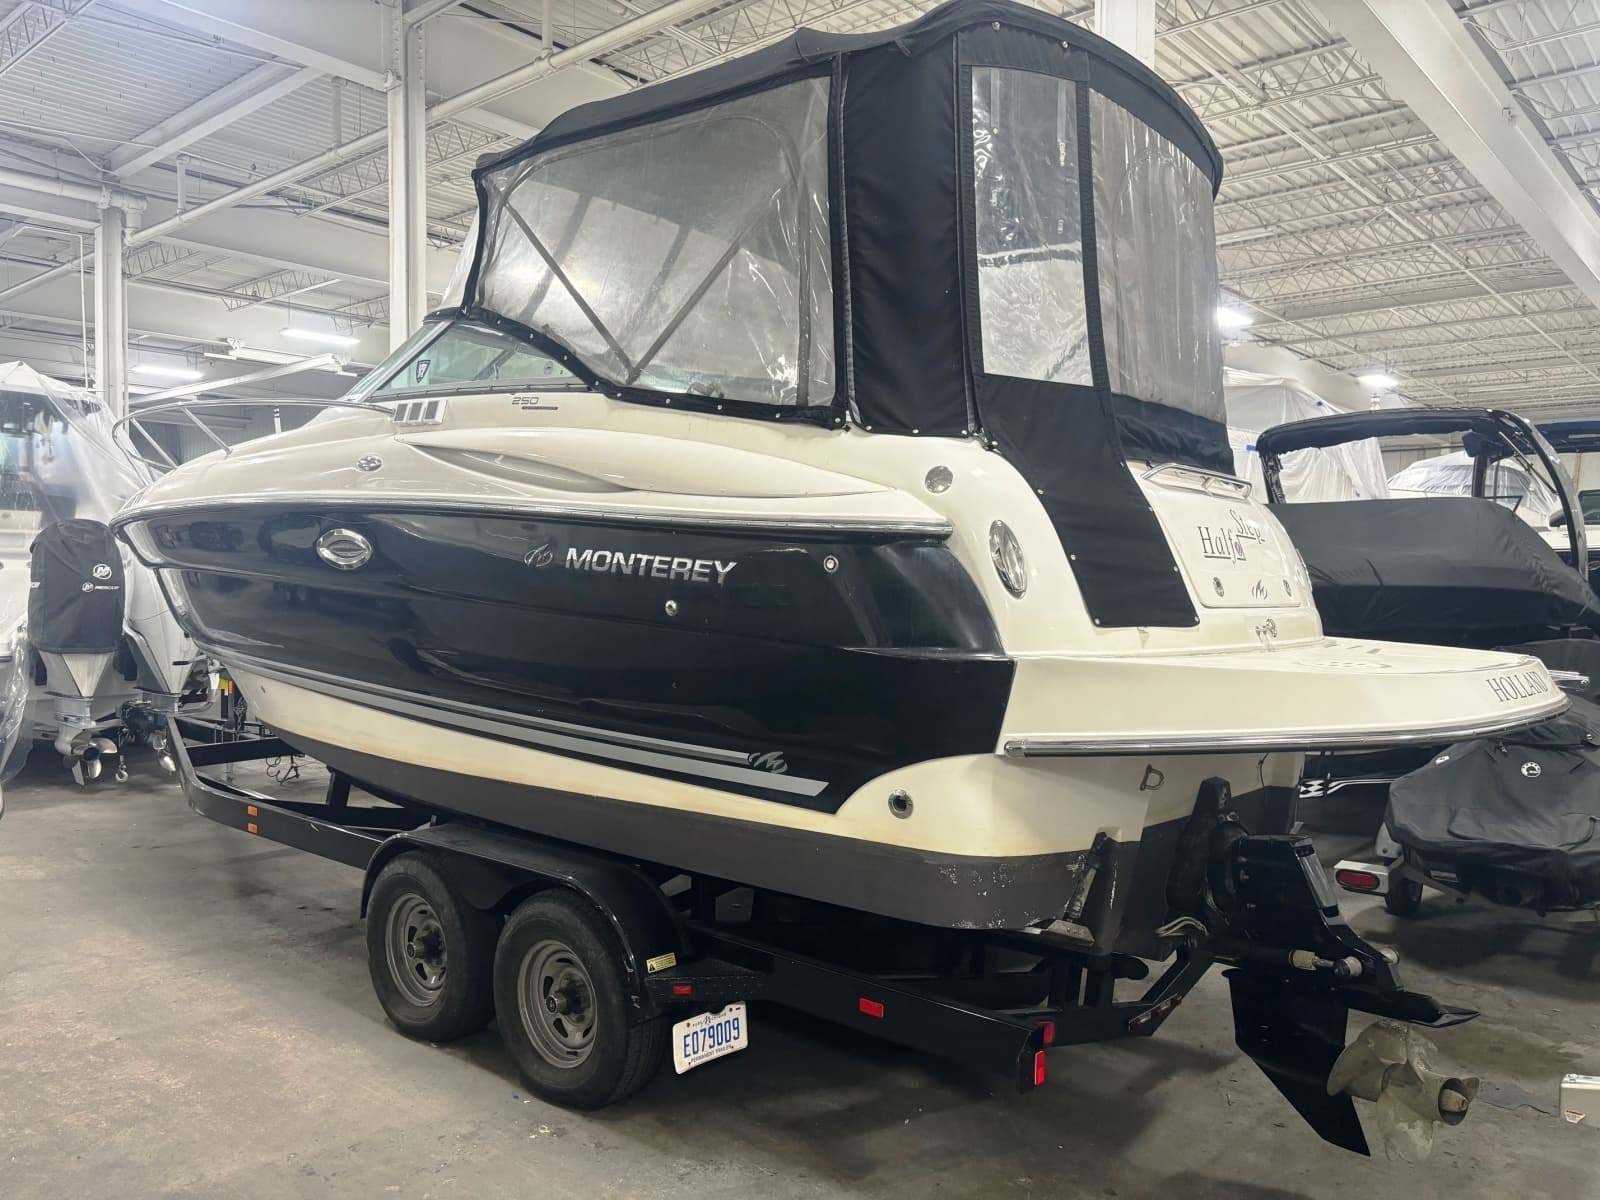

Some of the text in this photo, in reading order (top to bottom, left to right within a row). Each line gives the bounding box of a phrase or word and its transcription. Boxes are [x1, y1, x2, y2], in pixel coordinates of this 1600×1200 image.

[511, 396, 540, 405] 250
[1197, 526, 1236, 565] Half
[565, 547, 738, 585] MONTEREY
[1485, 671, 1548, 702] HOLLAND
[683, 1017, 740, 1058] E079009
